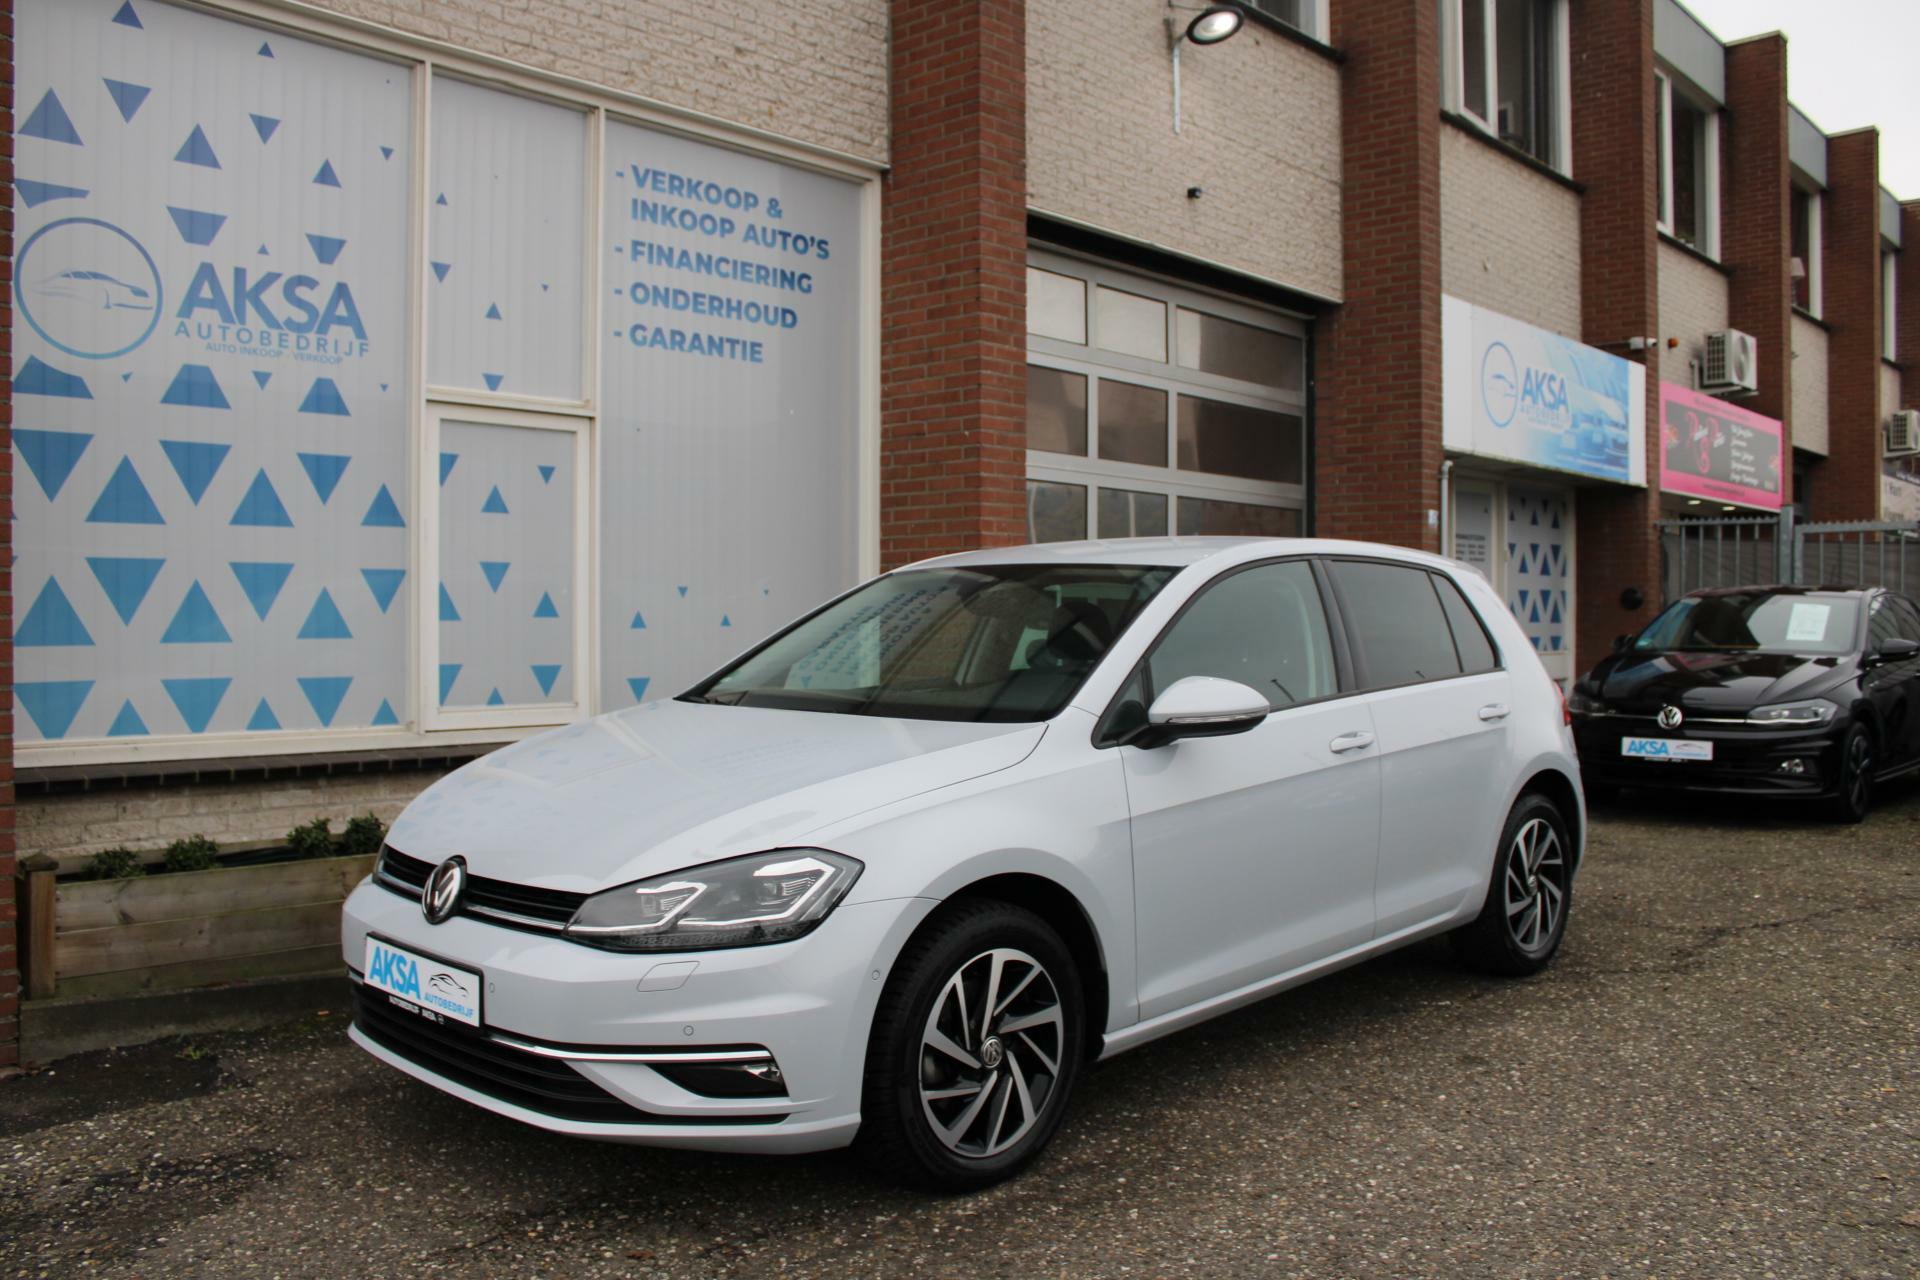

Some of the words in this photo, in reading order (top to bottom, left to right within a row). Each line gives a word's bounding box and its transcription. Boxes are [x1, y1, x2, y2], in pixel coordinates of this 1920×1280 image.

[631, 165, 759, 211] VERKOOP
[766, 197, 783, 219] &
[631, 198, 735, 238] INKOOP
[742, 223, 830, 260] AUTO'S
[630, 239, 812, 295] FINANCIERING
[176, 262, 368, 340] AKSA
[630, 282, 798, 329] ONDERHOUD
[174, 320, 369, 358] AUTOBEDRIJF
[206, 343, 237, 354] AUTO
[239, 345, 283, 359] INKOOP
[293, 352, 343, 365] VERKOOP
[629, 323, 764, 363] GARANTIE
[1521, 367, 1570, 414] AKSA
[1627, 739, 1669, 756] AKSA
[370, 946, 421, 999] AKSA
[424, 993, 474, 1019] AUTOBEDRIJF
